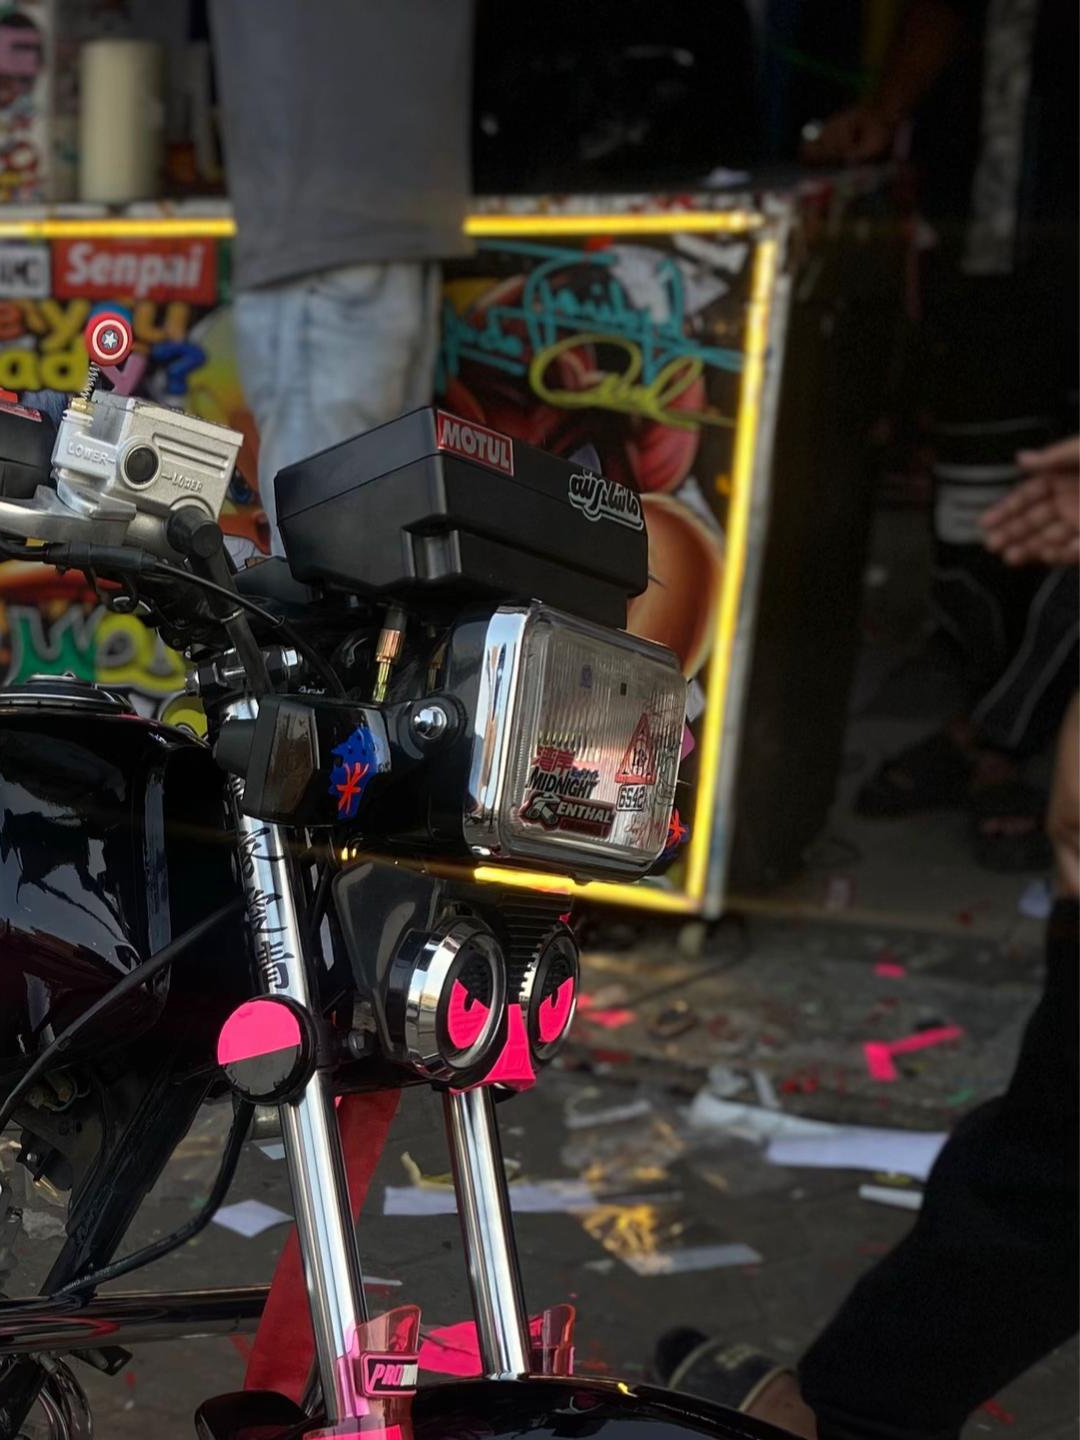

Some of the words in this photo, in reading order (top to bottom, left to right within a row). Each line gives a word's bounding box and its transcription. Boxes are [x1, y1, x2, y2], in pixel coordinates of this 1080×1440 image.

[65, 243, 203, 298] Senpai
[67, 441, 108, 466] LOWER
[443, 420, 510, 470] MOTUL
[172, 472, 204, 494] LOWER
[526, 766, 600, 800] MIDNIGHT
